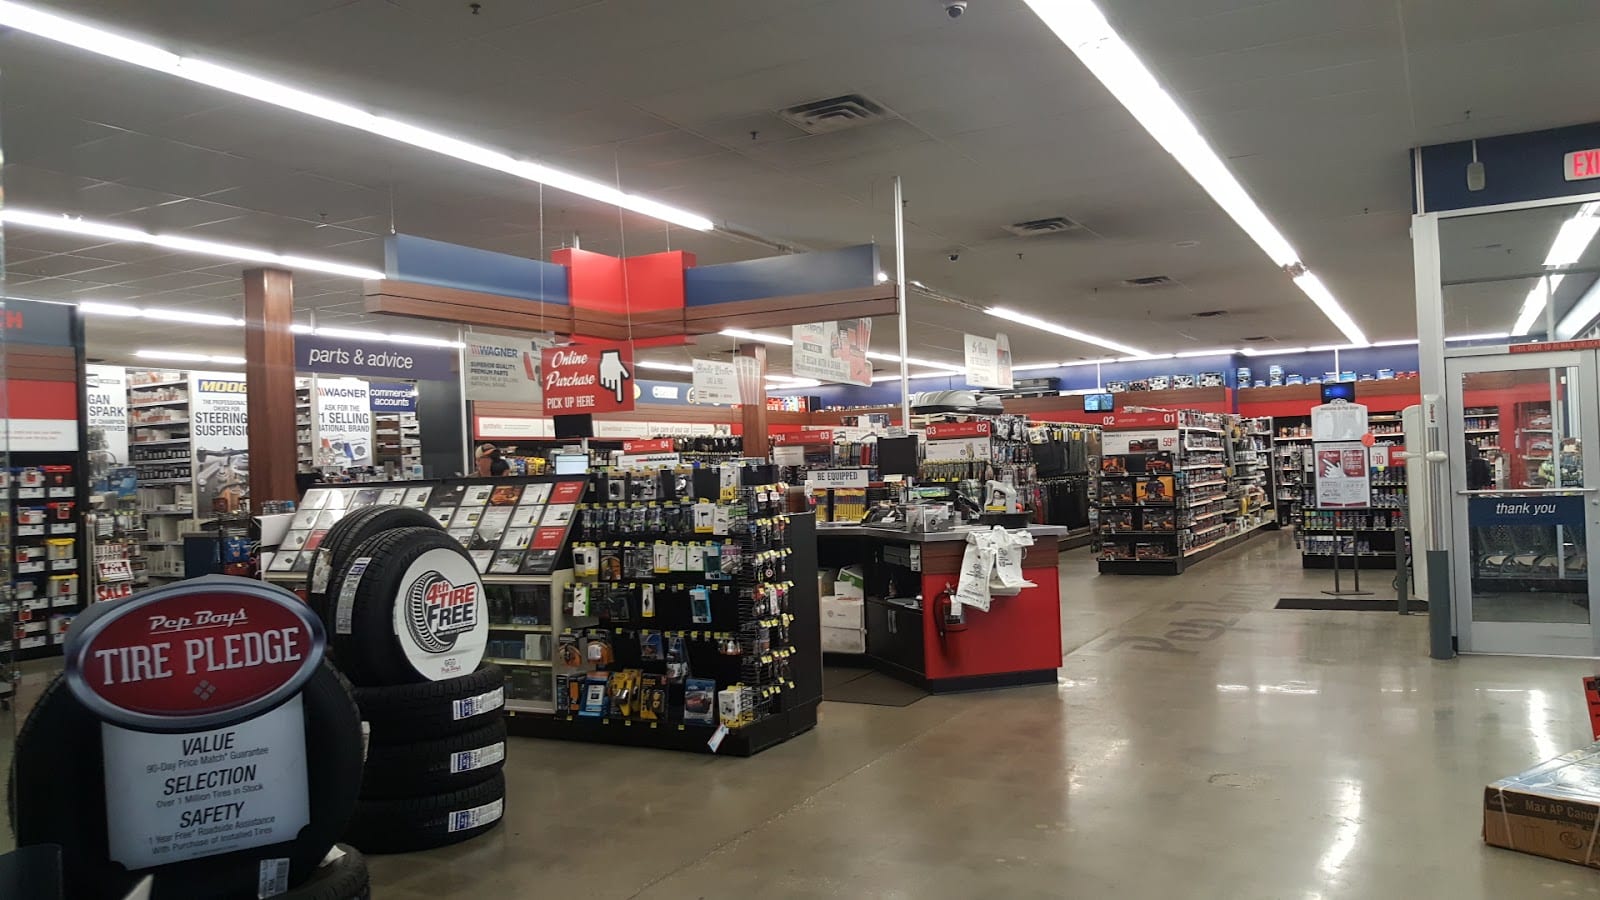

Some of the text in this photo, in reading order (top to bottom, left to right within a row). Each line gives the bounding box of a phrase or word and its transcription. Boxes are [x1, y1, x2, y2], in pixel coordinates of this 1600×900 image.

[308, 348, 414, 369] parts & advice
[479, 345, 518, 359] WAGNER
[552, 351, 589, 368] Online
[546, 373, 595, 391] Purchase
[325, 388, 367, 398] WAGNER
[324, 404, 336, 412] ASK
[374, 397, 410, 407] accounts
[547, 395, 596, 409] PICK UP HERE
[89, 406, 125, 417] SPARK
[195, 411, 249, 424] STEERING
[329, 413, 369, 424] SELLING
[1103, 416, 1115, 425] 02
[1163, 413, 1175, 423] 01
[349, 425, 370, 433] BRAND
[820, 431, 830, 440] 03
[926, 426, 937, 435] 03
[976, 423, 988, 433] 02
[660, 440, 669, 449] 04
[817, 471, 858, 481] BE EQUIPPED
[1496, 502, 1556, 515] thank you
[97, 583, 130, 602] SALE
[426, 580, 449, 606] 4th
[439, 585, 476, 608] TIRE
[149, 608, 249, 631] Pep Boys
[426, 603, 474, 632] FREE
[95, 627, 301, 685] TIRE PLEDGE
[182, 732, 236, 756] VALUE
[146, 762, 176, 774] 90-Day
[178, 757, 198, 768] Price
[230, 746, 269, 760] Guarantee
[163, 764, 257, 796] SELECTION
[156, 799, 176, 809] Over
[184, 793, 211, 803] Million
[213, 788, 232, 798] Tires
[234, 787, 241, 795] in
[242, 783, 263, 793] Stock
[180, 800, 245, 828] SAFETY
[1525, 799, 1598, 822] Max AP Cano
[198, 824, 234, 836] Roadside
[235, 815, 276, 829] Assistance
[172, 839, 209, 851] Purchase
[254, 827, 273, 836] Tires
